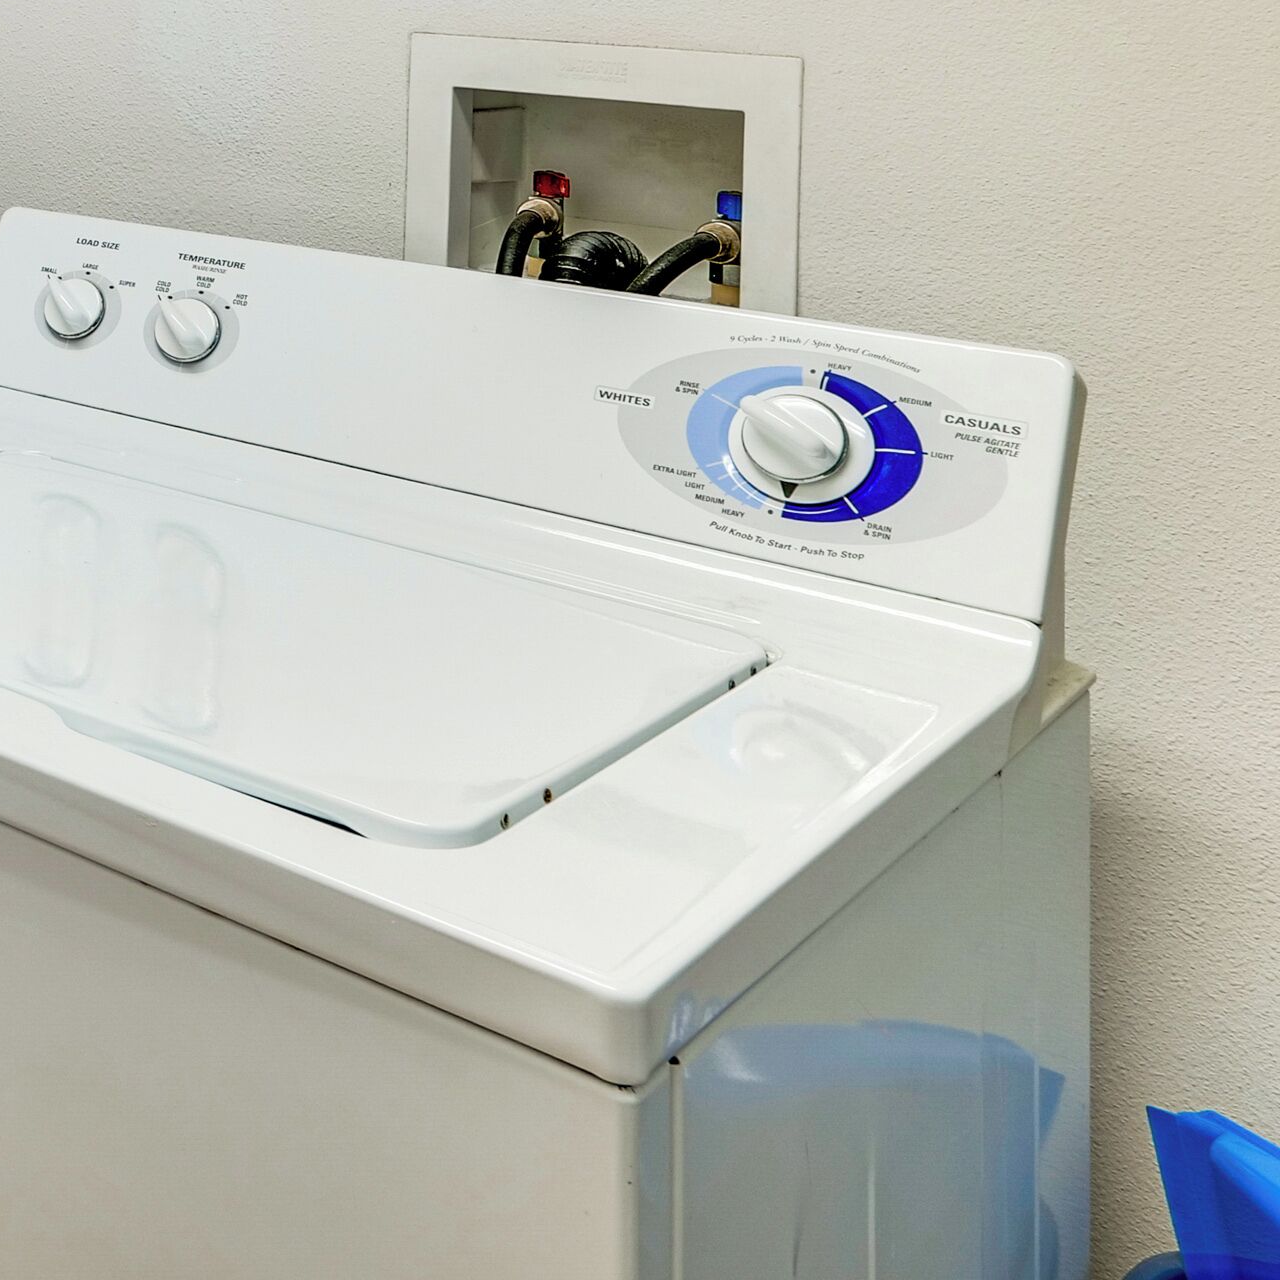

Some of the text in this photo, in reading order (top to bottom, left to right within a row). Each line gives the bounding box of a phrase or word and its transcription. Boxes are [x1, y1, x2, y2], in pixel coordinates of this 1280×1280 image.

[76, 238, 120, 250] LOAD SIZE
[178, 253, 246, 270] TEMPERATURE
[41, 266, 58, 274] SMALL
[118, 280, 136, 288] SUPER
[157, 280, 172, 288] COLD
[738, 335, 762, 344] Cycles
[780, 336, 801, 344] Wash
[812, 339, 831, 348] Spin
[833, 343, 860, 354] Speed
[862, 349, 920, 374] Combinations
[828, 362, 852, 372] HEAVY
[680, 380, 700, 388] RINSE
[682, 387, 699, 395] SPIN
[599, 389, 651, 406] WHITES
[898, 396, 932, 407] MEDIUM
[944, 414, 1022, 436] CASUALS
[955, 432, 1022, 450] PULSE AGITATE
[930, 451, 954, 460] LIGHT
[985, 446, 1019, 458] GENTLE
[653, 464, 696, 478] EXTRA LIGHT
[684, 481, 705, 490] LIGHT
[695, 494, 724, 504] MEDIUM
[722, 508, 744, 518] HEAVY
[867, 522, 892, 532] DRAIN
[709, 521, 728, 532] Pull
[728, 528, 754, 540] Knob
[755, 536, 765, 544] To
[768, 539, 792, 550] Start
[800, 546, 824, 556] Push
[827, 549, 838, 558] To
[840, 550, 865, 560] Stop
[872, 531, 890, 540] SPIN
